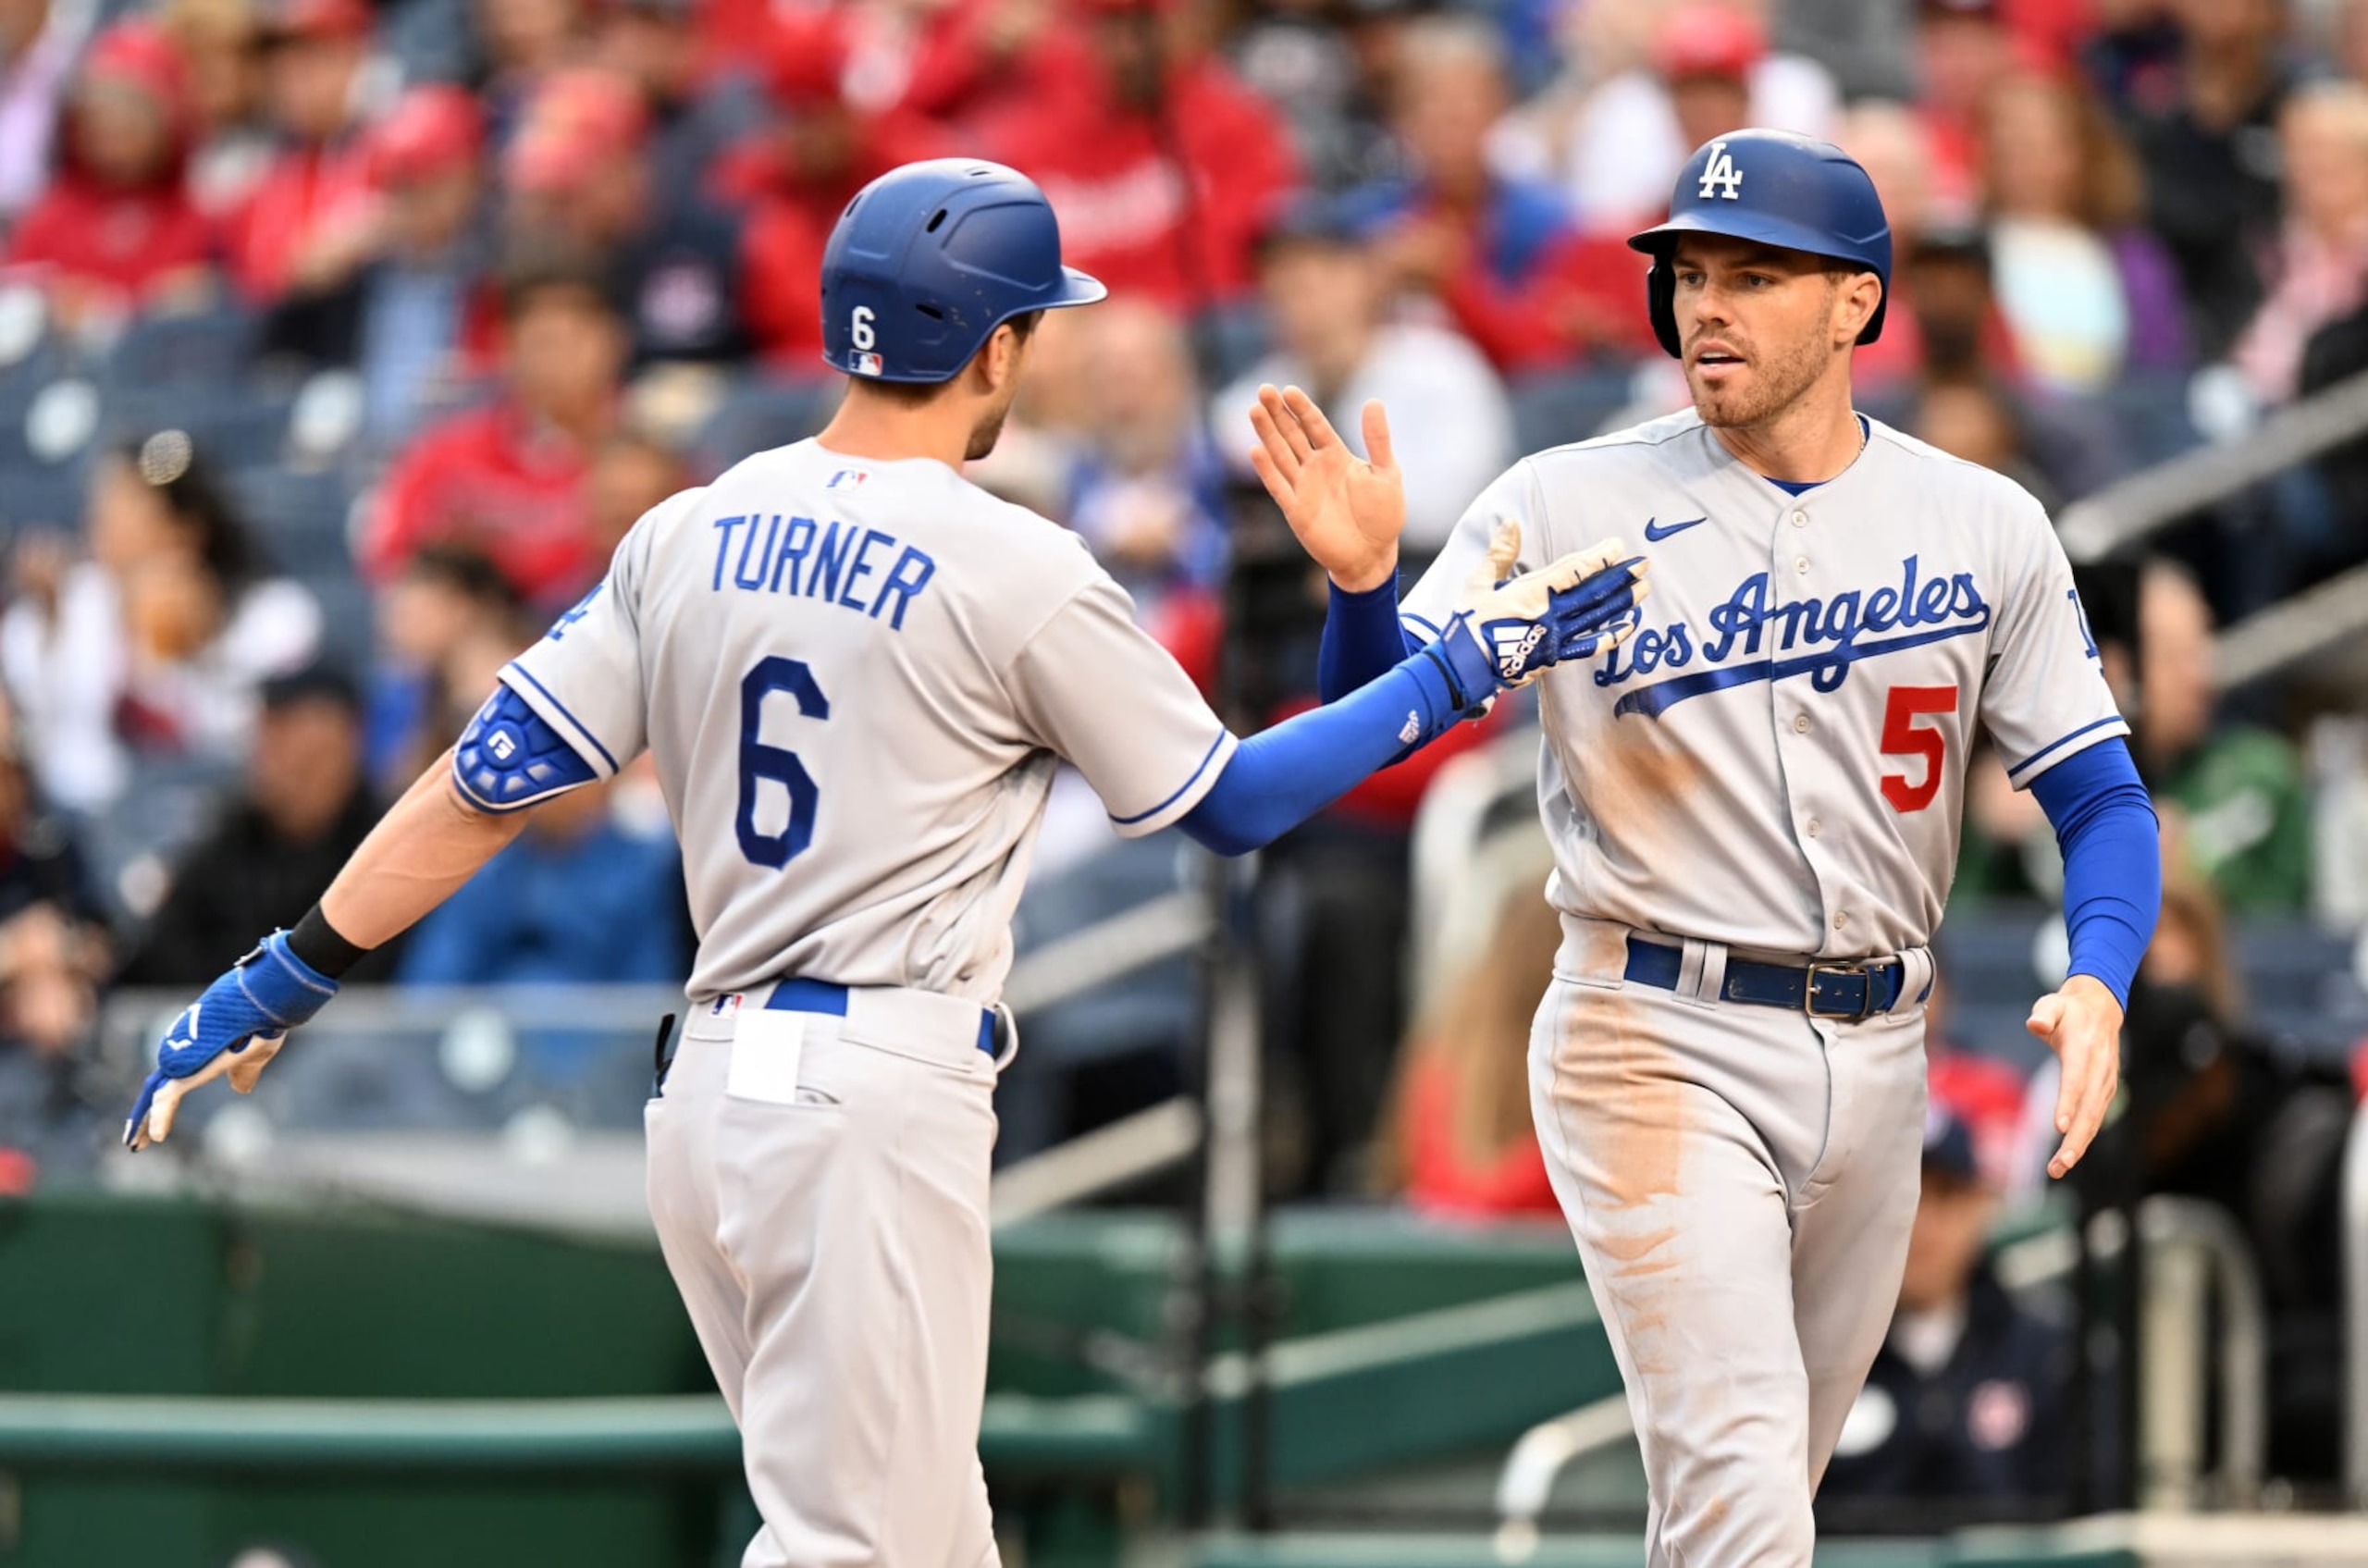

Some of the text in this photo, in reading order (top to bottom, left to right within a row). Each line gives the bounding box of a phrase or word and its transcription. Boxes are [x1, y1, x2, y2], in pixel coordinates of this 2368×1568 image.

[1698, 142, 1744, 201] LA
[851, 305, 876, 351] 6
[712, 513, 936, 632] TURNER
[1702, 553, 1989, 693] Angeles
[1502, 623, 1548, 678] adidas
[734, 655, 831, 871] 6
[1880, 685, 1959, 814] 5
